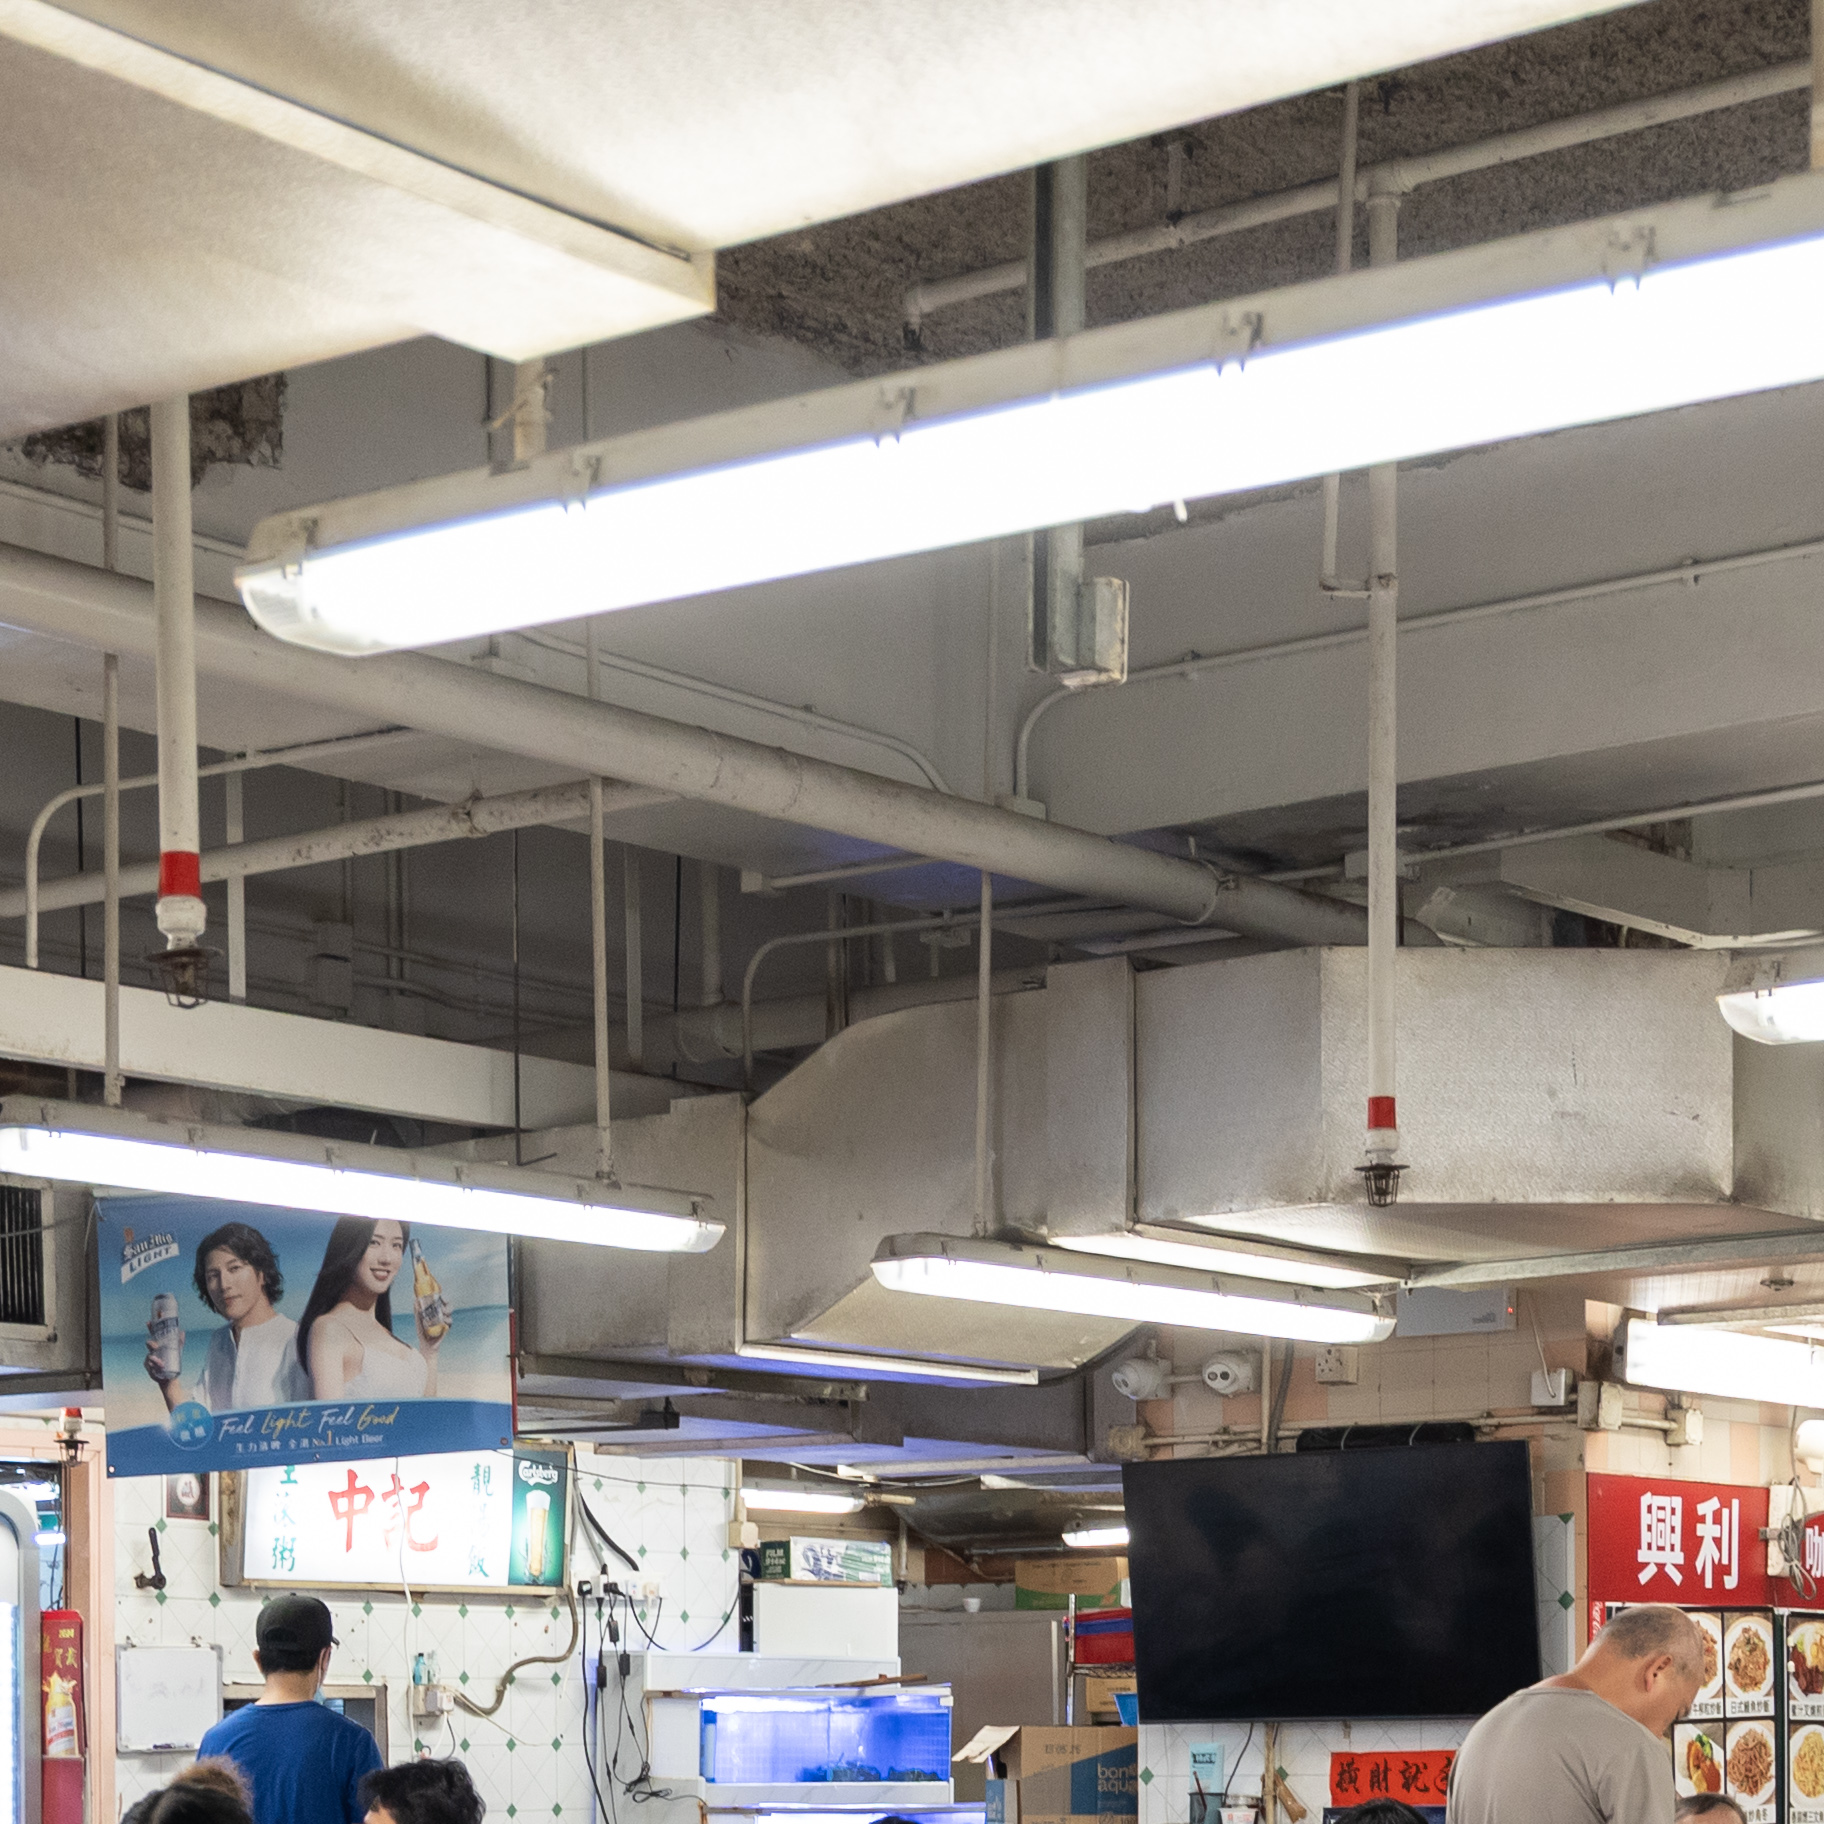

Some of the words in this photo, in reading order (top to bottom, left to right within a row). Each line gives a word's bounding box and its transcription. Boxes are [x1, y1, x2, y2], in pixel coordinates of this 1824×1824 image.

[129, 1246, 172, 1273] LIGHT
[218, 1414, 255, 1442] Feel
[260, 1408, 312, 1440] Light
[318, 1406, 356, 1434] Feel
[357, 1404, 400, 1432] Good
[518, 1460, 559, 1487] Carlsberg
[327, 1468, 438, 1553] 中記
[1637, 1490, 1740, 1590] 興利
